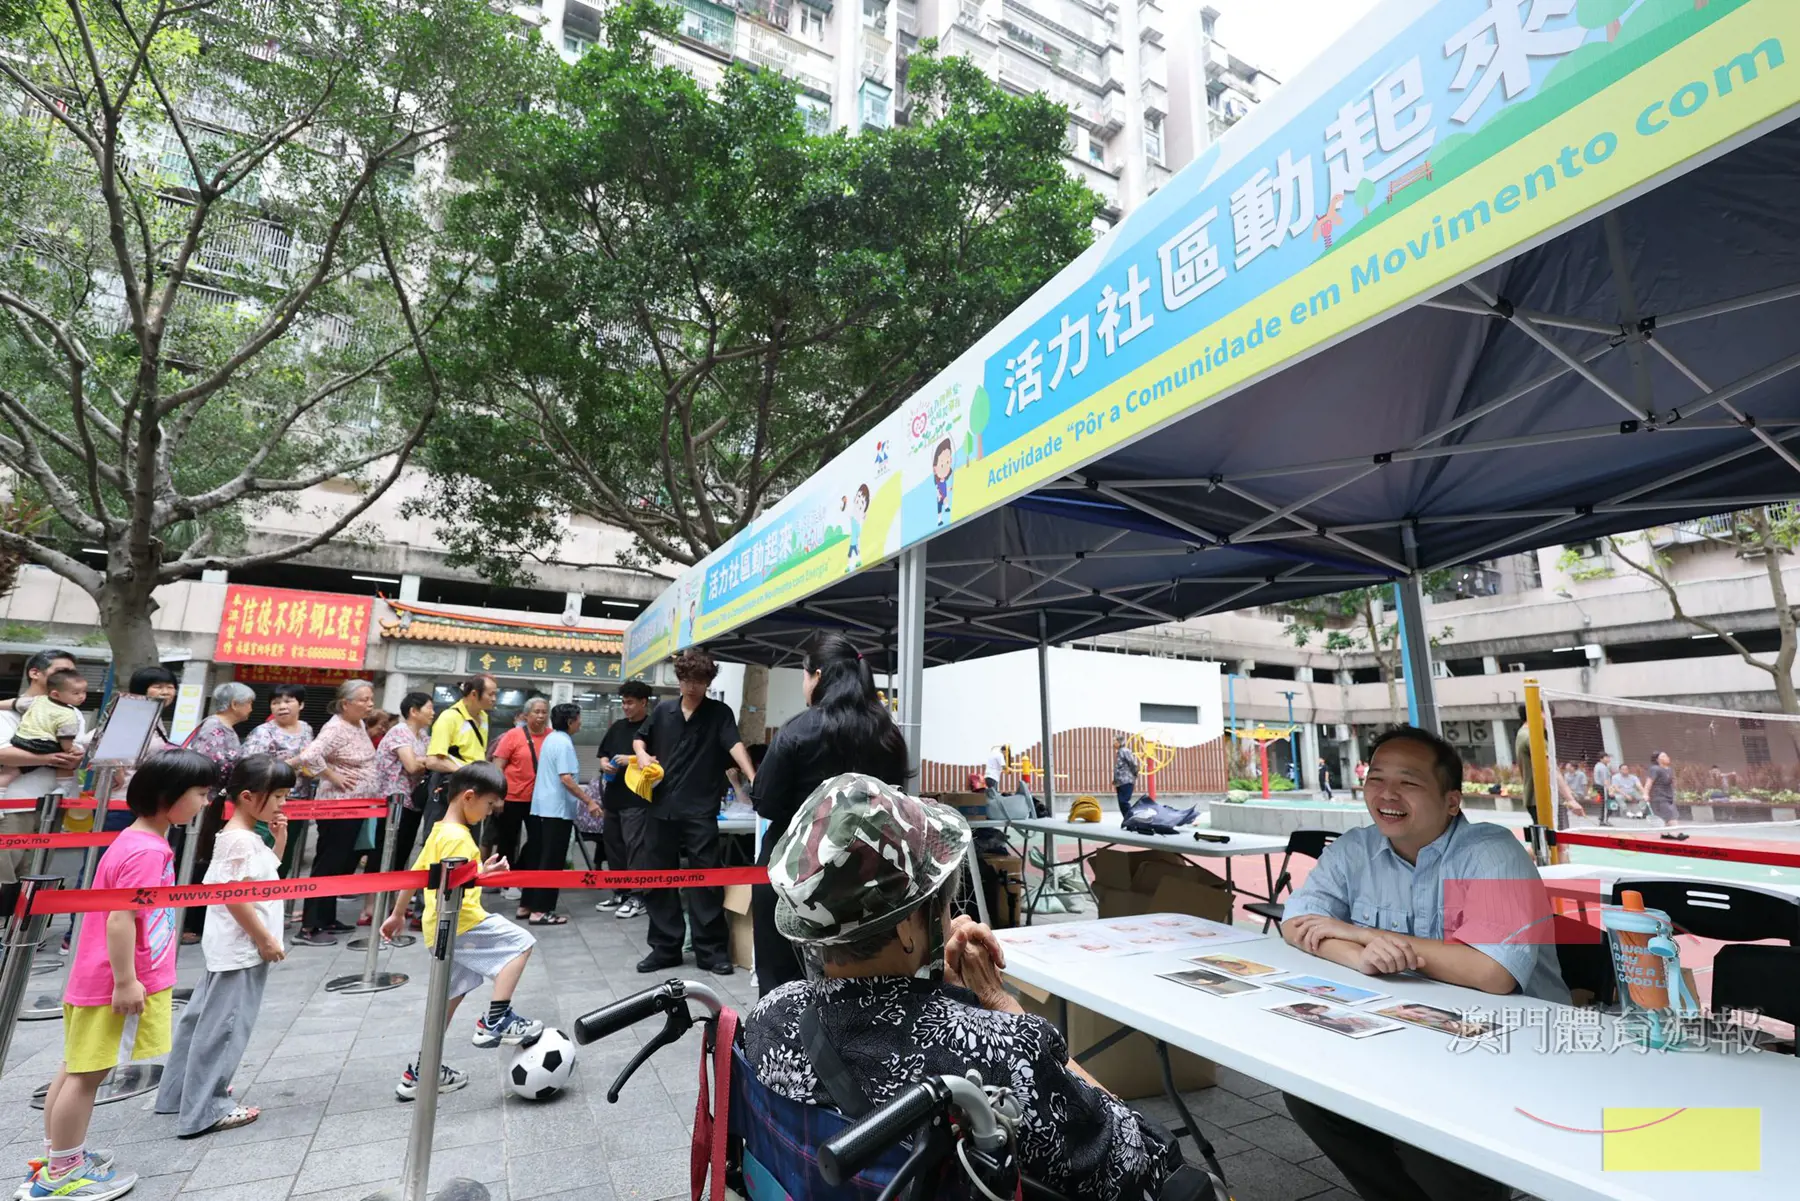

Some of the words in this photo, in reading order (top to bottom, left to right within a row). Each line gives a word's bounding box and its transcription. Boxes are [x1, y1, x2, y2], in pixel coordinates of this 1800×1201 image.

[1003, 0, 1590, 417] 活力社區動起來
[987, 436, 1062, 487] Actividade
[1110, 403, 1121, 423] a
[1126, 314, 1281, 413] Comunidade
[1290, 283, 1340, 325] em
[1350, 131, 1618, 294] Movimento
[1635, 37, 1785, 136] com
[604, 872, 705, 886] www.sport.gov.mo
[168, 881, 318, 902] www.sport.gov.mo
[1616, 963, 1643, 975] LIVE
[1618, 974, 1653, 986] GOOD
